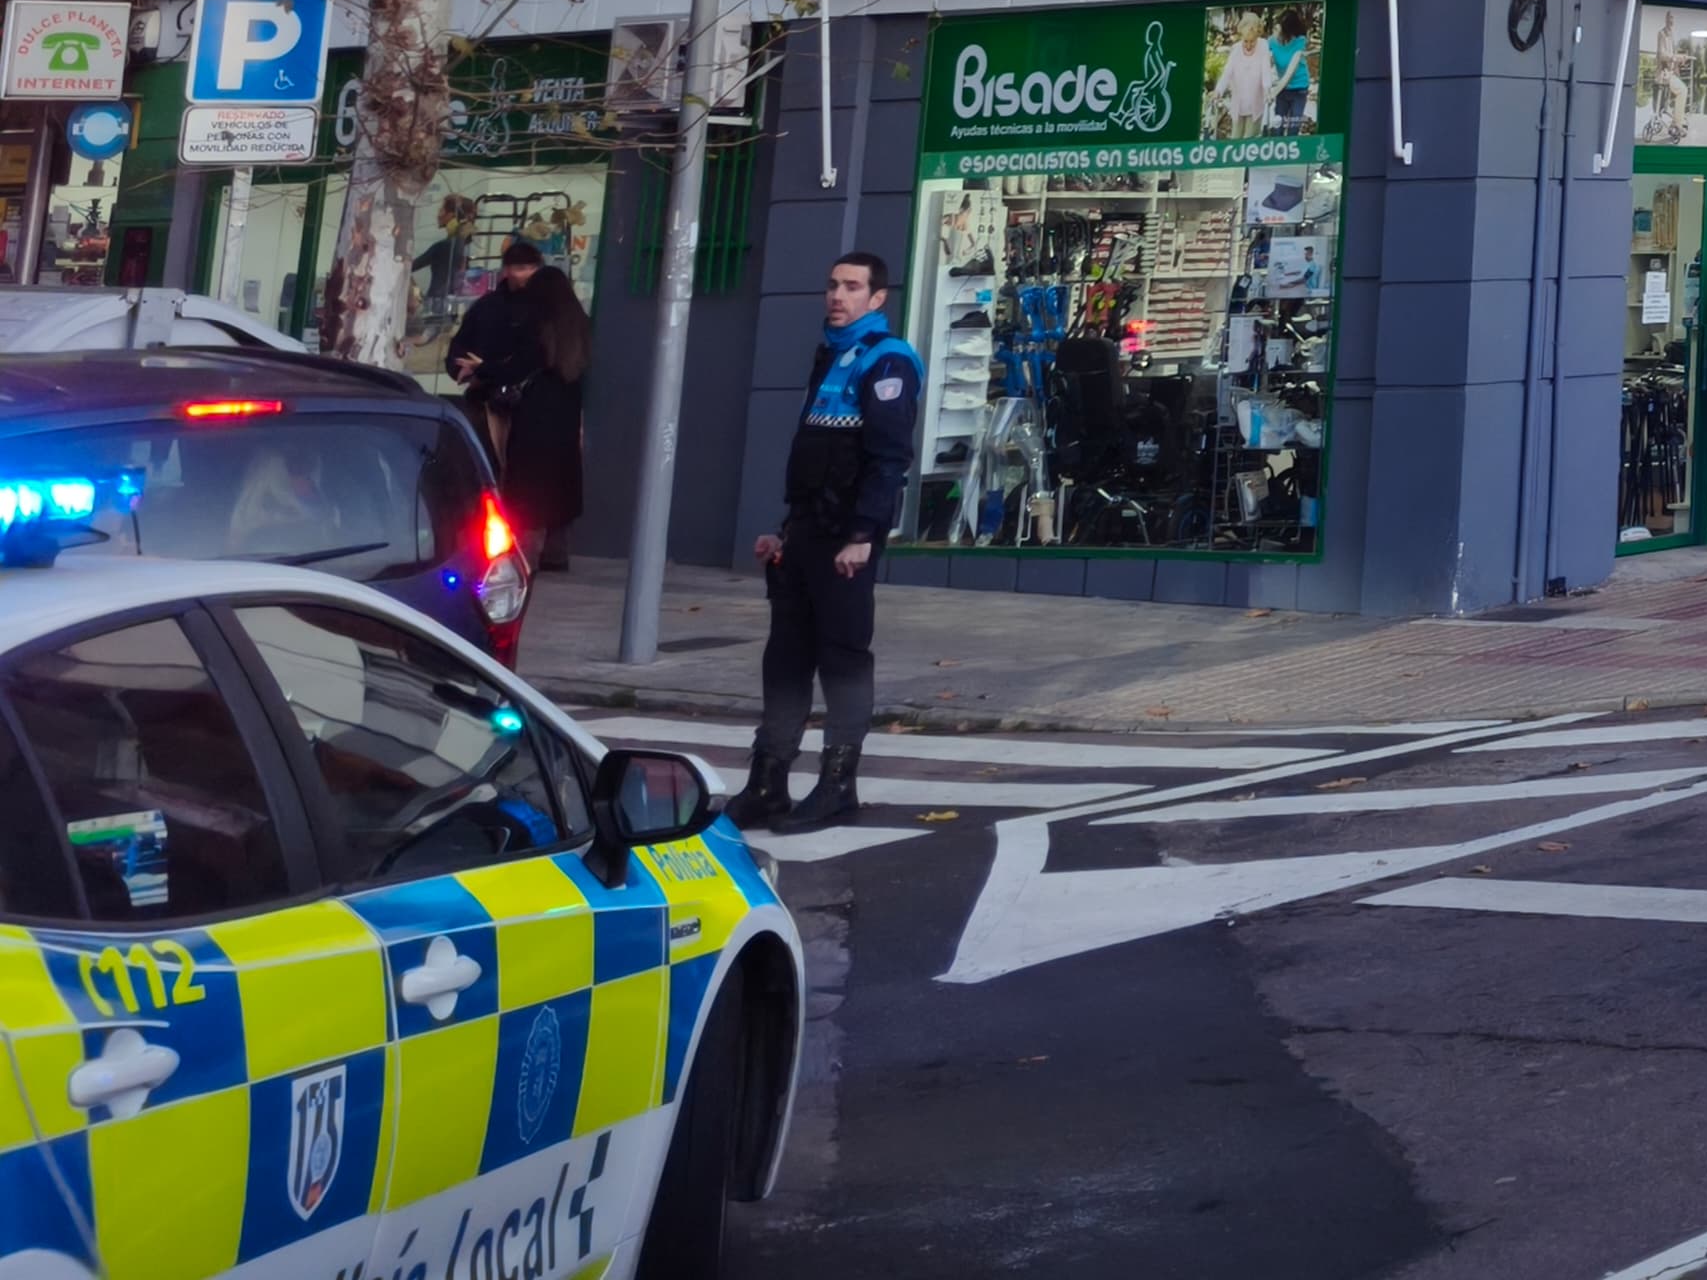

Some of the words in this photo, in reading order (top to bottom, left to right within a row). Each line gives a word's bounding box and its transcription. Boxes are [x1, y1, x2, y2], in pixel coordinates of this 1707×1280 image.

[18, 12, 63, 57] DULCE
[68, 10, 123, 59] PLANETA
[216, 1, 302, 90] P
[17, 78, 117, 90] INTERNET
[953, 43, 1118, 120] Bisade
[189, 142, 248, 154] MOVILIDAD
[250, 143, 305, 154] REDUCIDA
[266, 130, 292, 142] CON
[950, 124, 988, 140] Ayudas
[990, 122, 1034, 136] técnicas
[1035, 124, 1042, 134] a
[1044, 121, 1056, 134] la
[959, 149, 1091, 174] especialistas
[1095, 149, 1122, 168] en
[1127, 145, 1186, 167] sillas
[1188, 140, 1217, 165] de
[1221, 139, 1301, 165] ruedas
[98, 939, 206, 1014] 112
